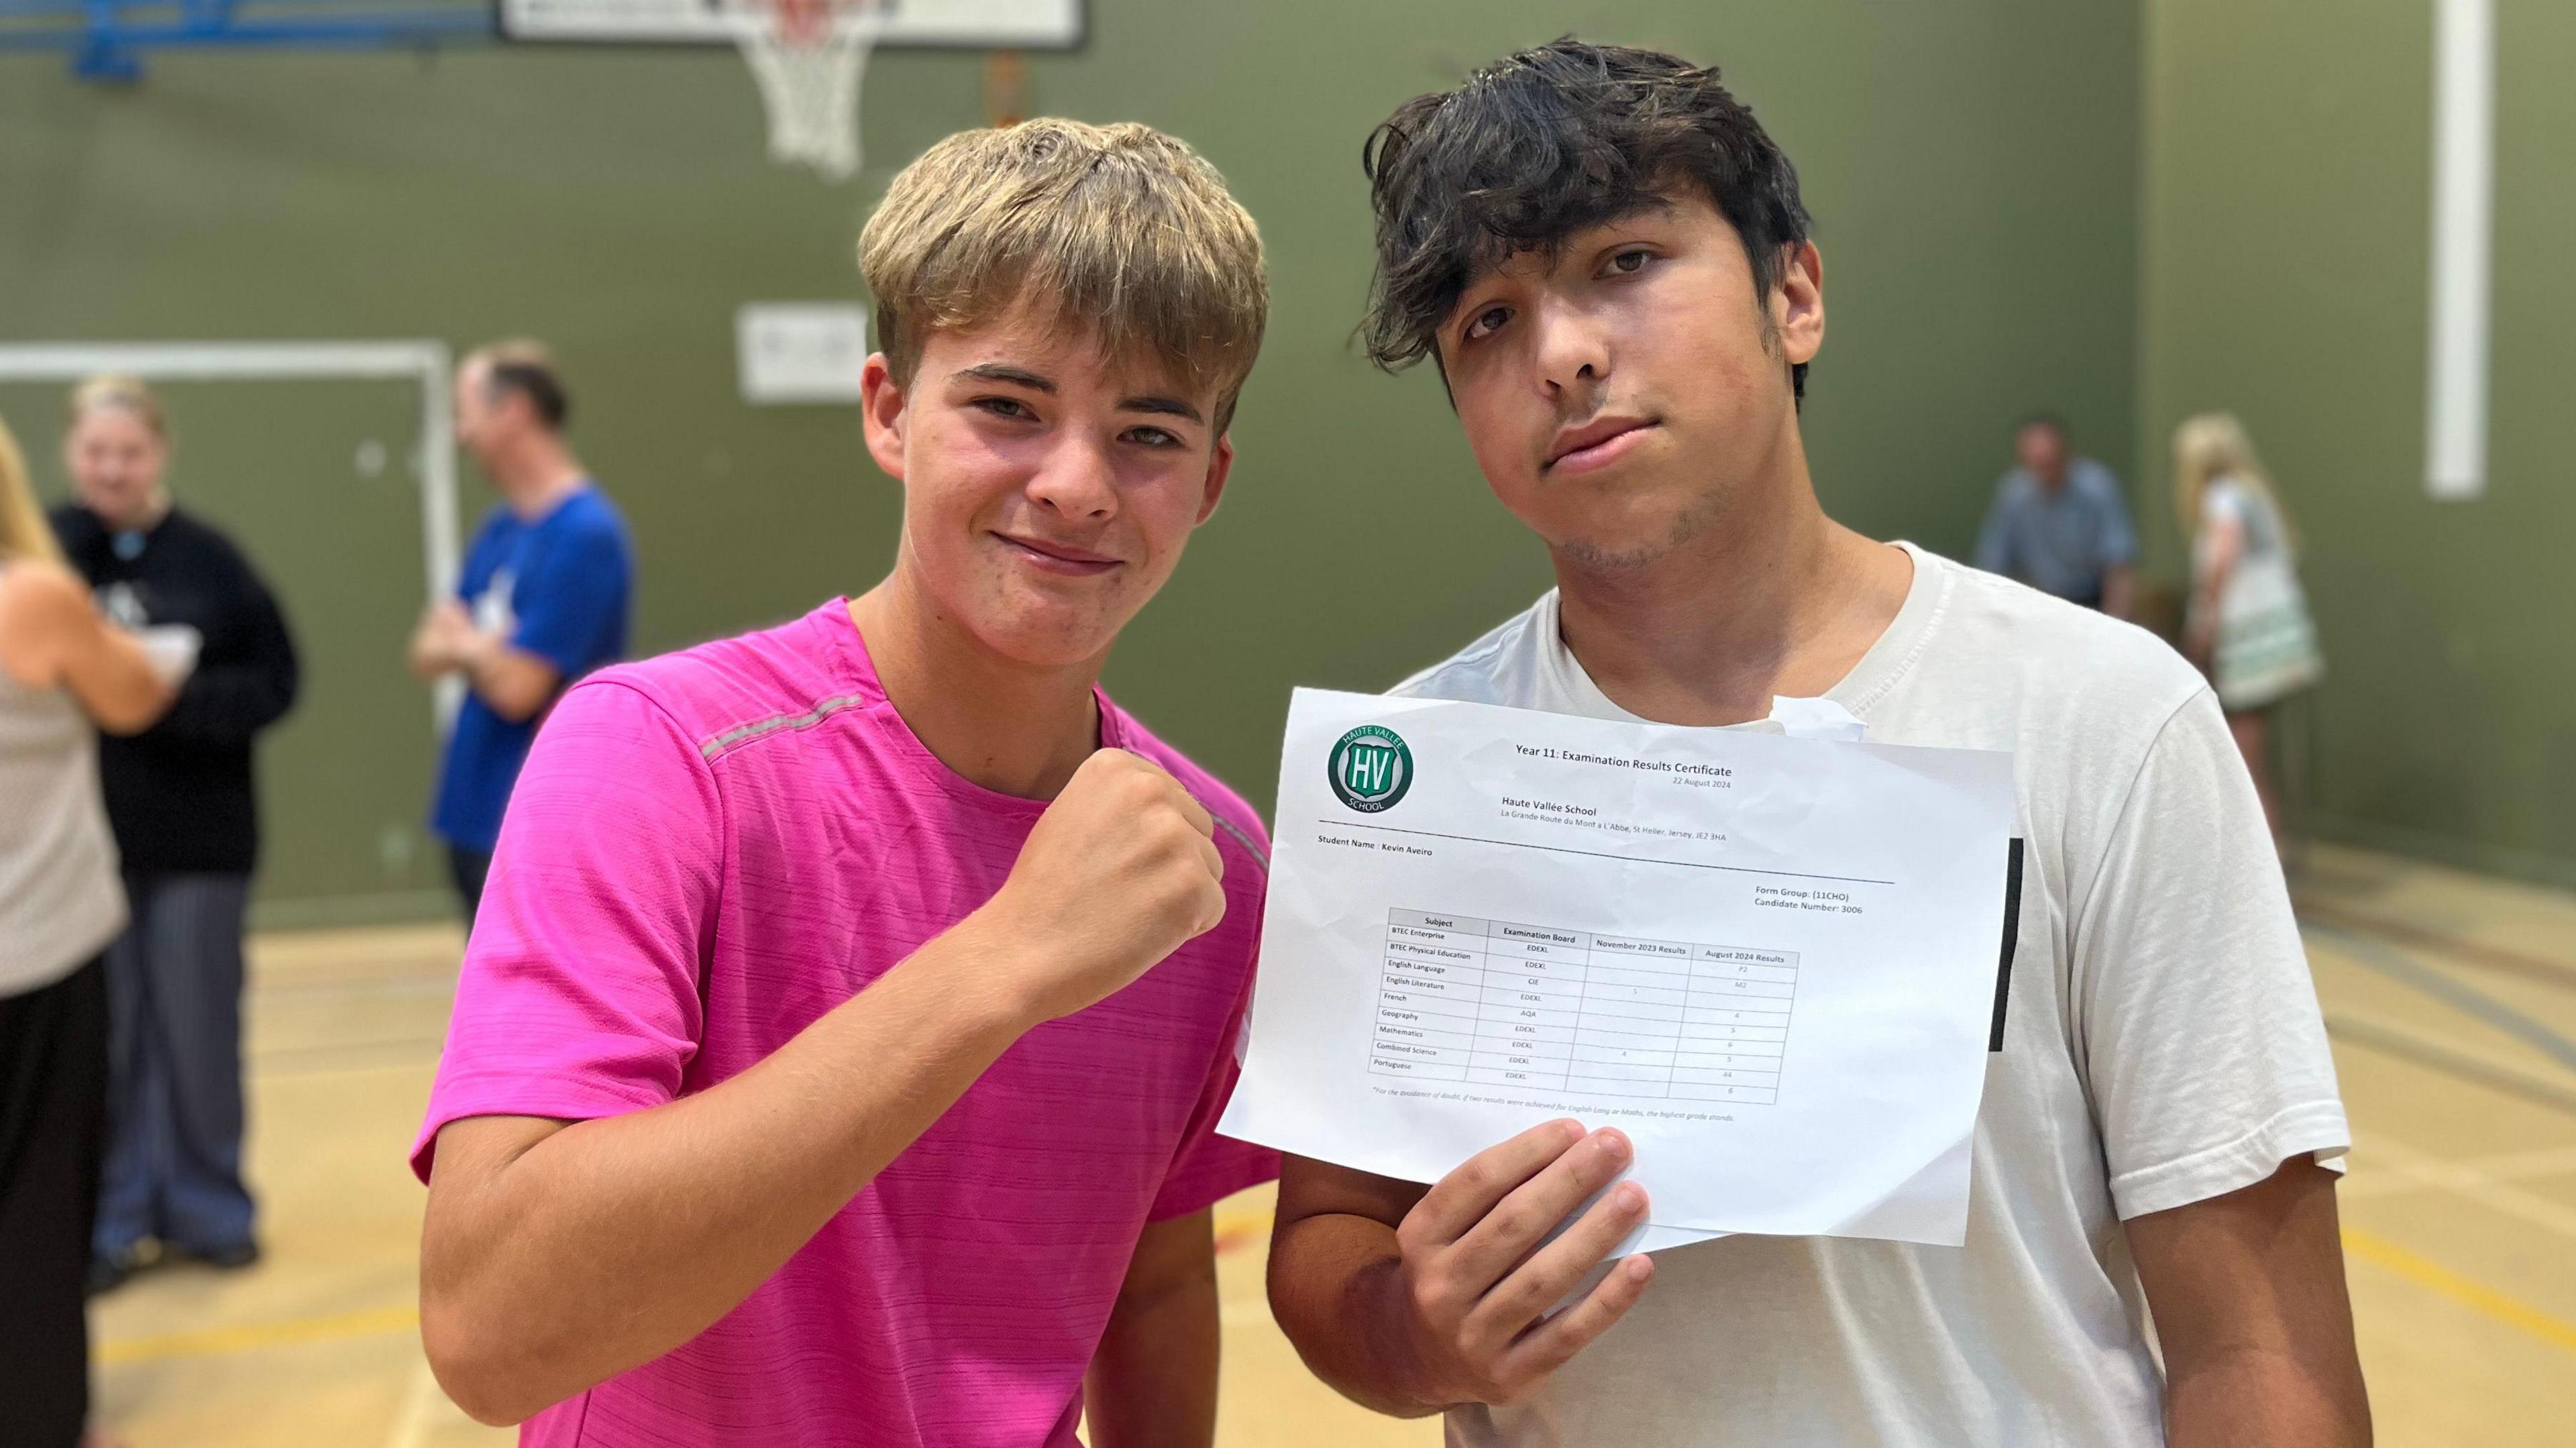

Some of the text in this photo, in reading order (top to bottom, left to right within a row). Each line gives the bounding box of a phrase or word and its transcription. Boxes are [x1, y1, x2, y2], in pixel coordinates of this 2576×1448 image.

[1343, 726, 1373, 744] HAUTE
[1516, 744, 1732, 777] Year 11: Examination Results Certificate
[1352, 748, 1389, 790] HV
[1672, 777, 1731, 789] 22 August 2024
[1348, 797, 1385, 812] SCHOOL
[1502, 797, 1597, 816] Haute Vallée School
[1501, 810, 1510, 818] La
[1511, 810, 1538, 820] Grande
[1540, 814, 1562, 824] Route
[1564, 817, 1574, 825] du
[1575, 819, 1596, 828] Mont
[1696, 832, 1709, 840] JE2
[1710, 833, 1727, 841] 3HA
[1318, 835, 1350, 846] Student
[1351, 840, 1375, 849] Name
[1382, 843, 1404, 852] Kevin
[1406, 846, 1433, 856] Aveiro
[1756, 886, 1849, 903] Form Group: (11CHO)
[1754, 897, 1863, 914] Candidate Number: 3006
[1425, 917, 1453, 928] Subject
[1392, 927, 1445, 940] BTEC Enterprise
[1503, 928, 1576, 944] Examination Board
[1390, 943, 1471, 960] BTEC Physical Education
[1527, 944, 1549, 953] EDEXL
[1597, 940, 1686, 954] November 2023 Results
[1705, 949, 1784, 963] August 2024 Results
[1388, 960, 1446, 974] English Language
[1525, 961, 1546, 970] EDEXL
[1387, 976, 1444, 990] English Literature
[1384, 993, 1407, 1002] French
[1521, 994, 1542, 1002] EDEXL
[1381, 1009, 1419, 1021] Geography
[1379, 1026, 1423, 1038] Mathematics
[1515, 1025, 1536, 1034] EDEXL
[1377, 1042, 1437, 1056] Combined Science
[1512, 1042, 1533, 1050] EDEXL
[1374, 1058, 1411, 1070] Portuguese
[1525, 1101, 1556, 1109] achieved
[1555, 1103, 1566, 1111] for
